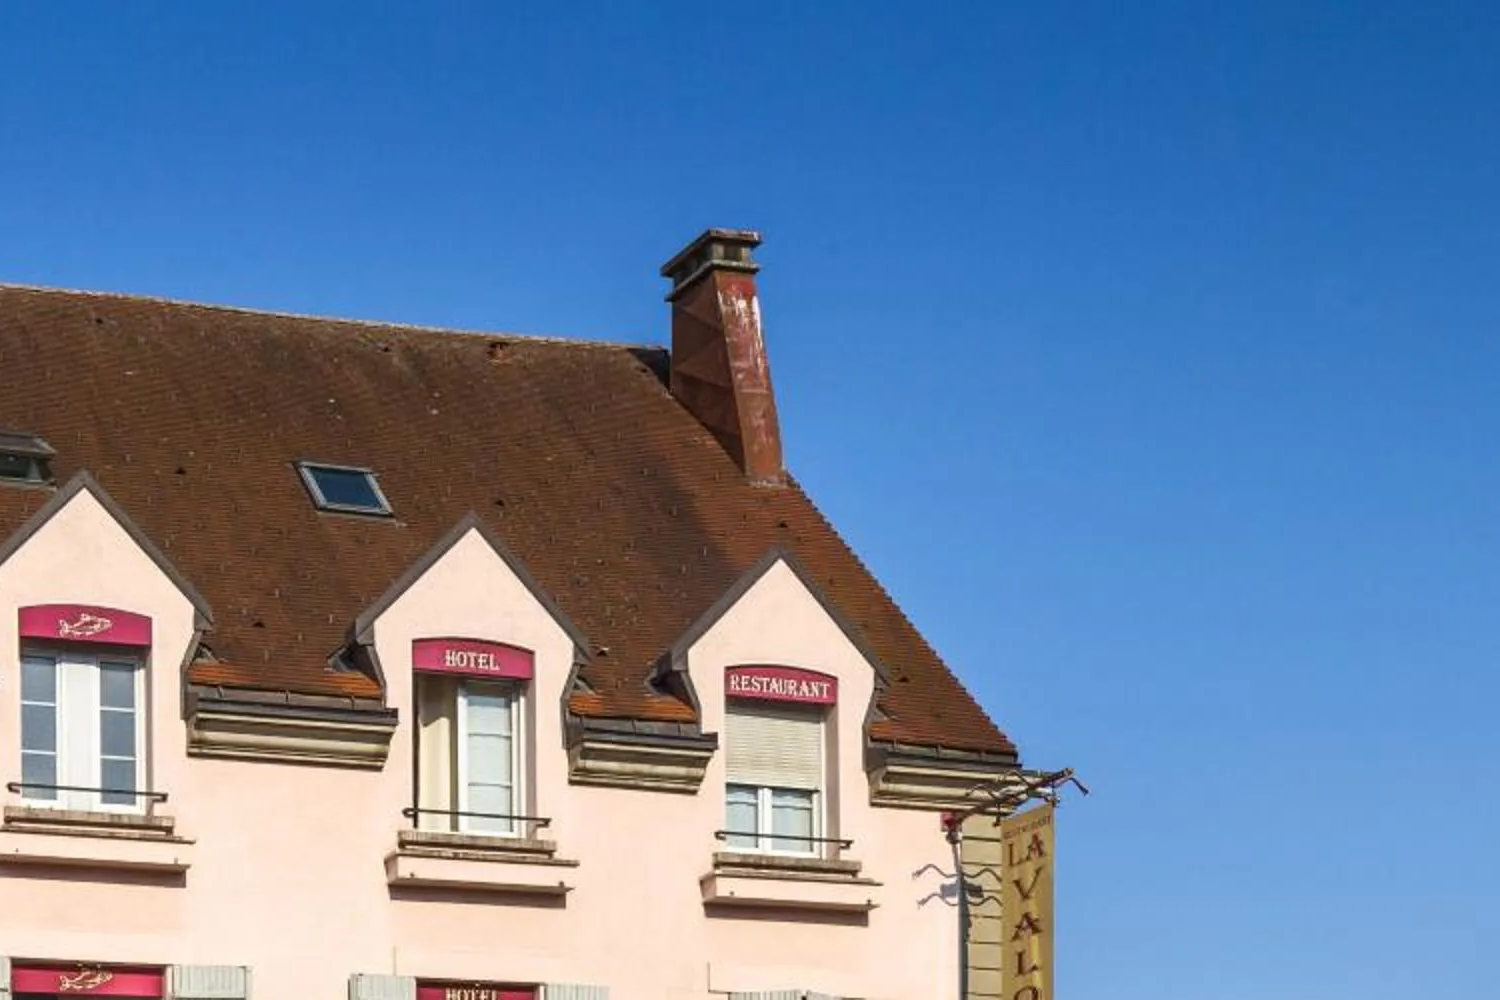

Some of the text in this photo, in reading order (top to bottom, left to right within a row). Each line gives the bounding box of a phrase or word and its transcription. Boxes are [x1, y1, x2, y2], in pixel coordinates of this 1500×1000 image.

[444, 649, 501, 671] HOTEL
[729, 675, 831, 699] RESTAURANT
[1007, 834, 1045, 868] LA
